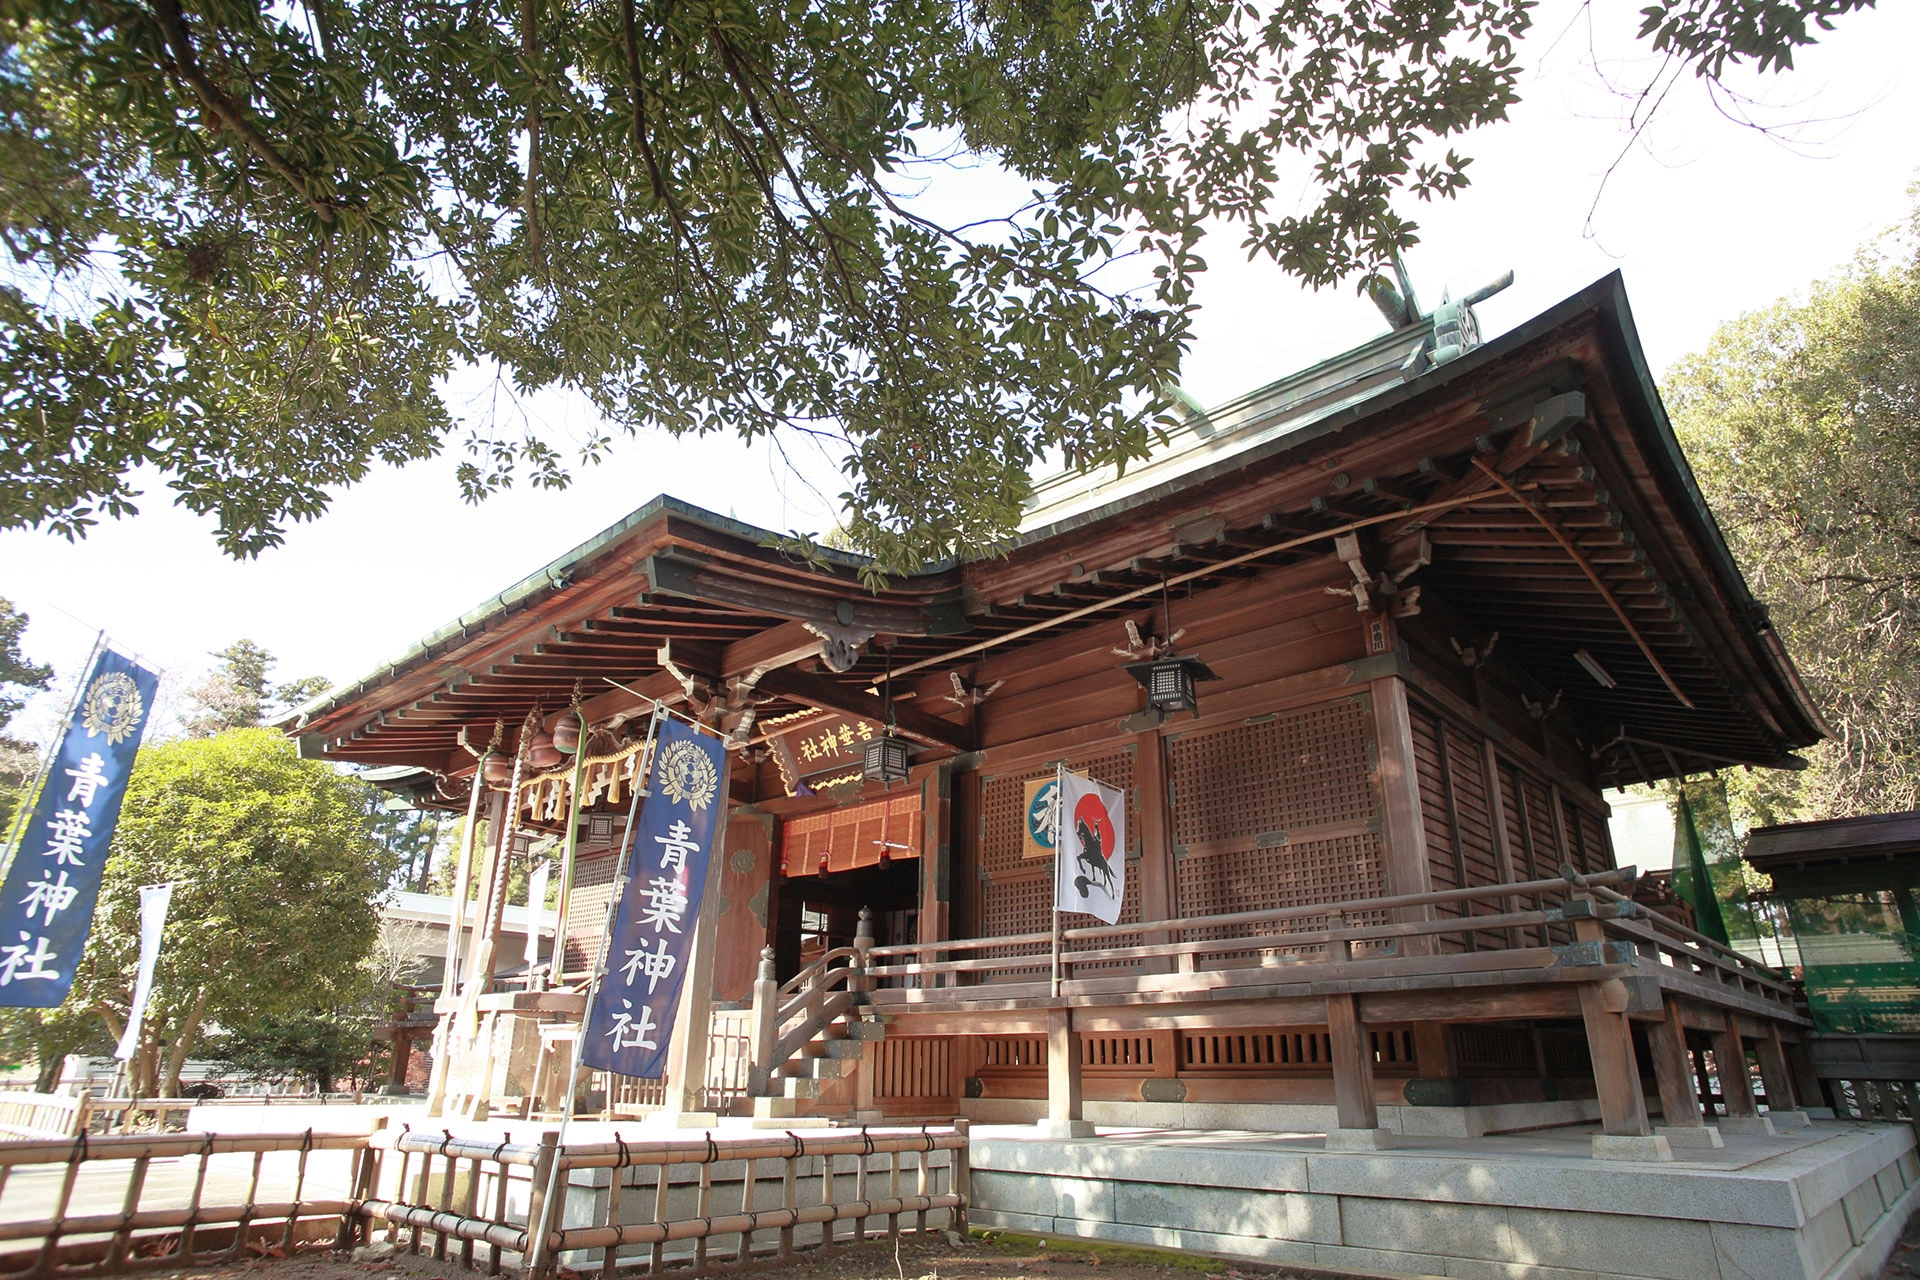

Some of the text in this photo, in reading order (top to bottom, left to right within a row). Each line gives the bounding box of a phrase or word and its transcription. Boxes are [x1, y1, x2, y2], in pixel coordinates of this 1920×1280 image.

[0, 753, 109, 986] 青葉神社
[604, 819, 700, 1053] 青葉神社
